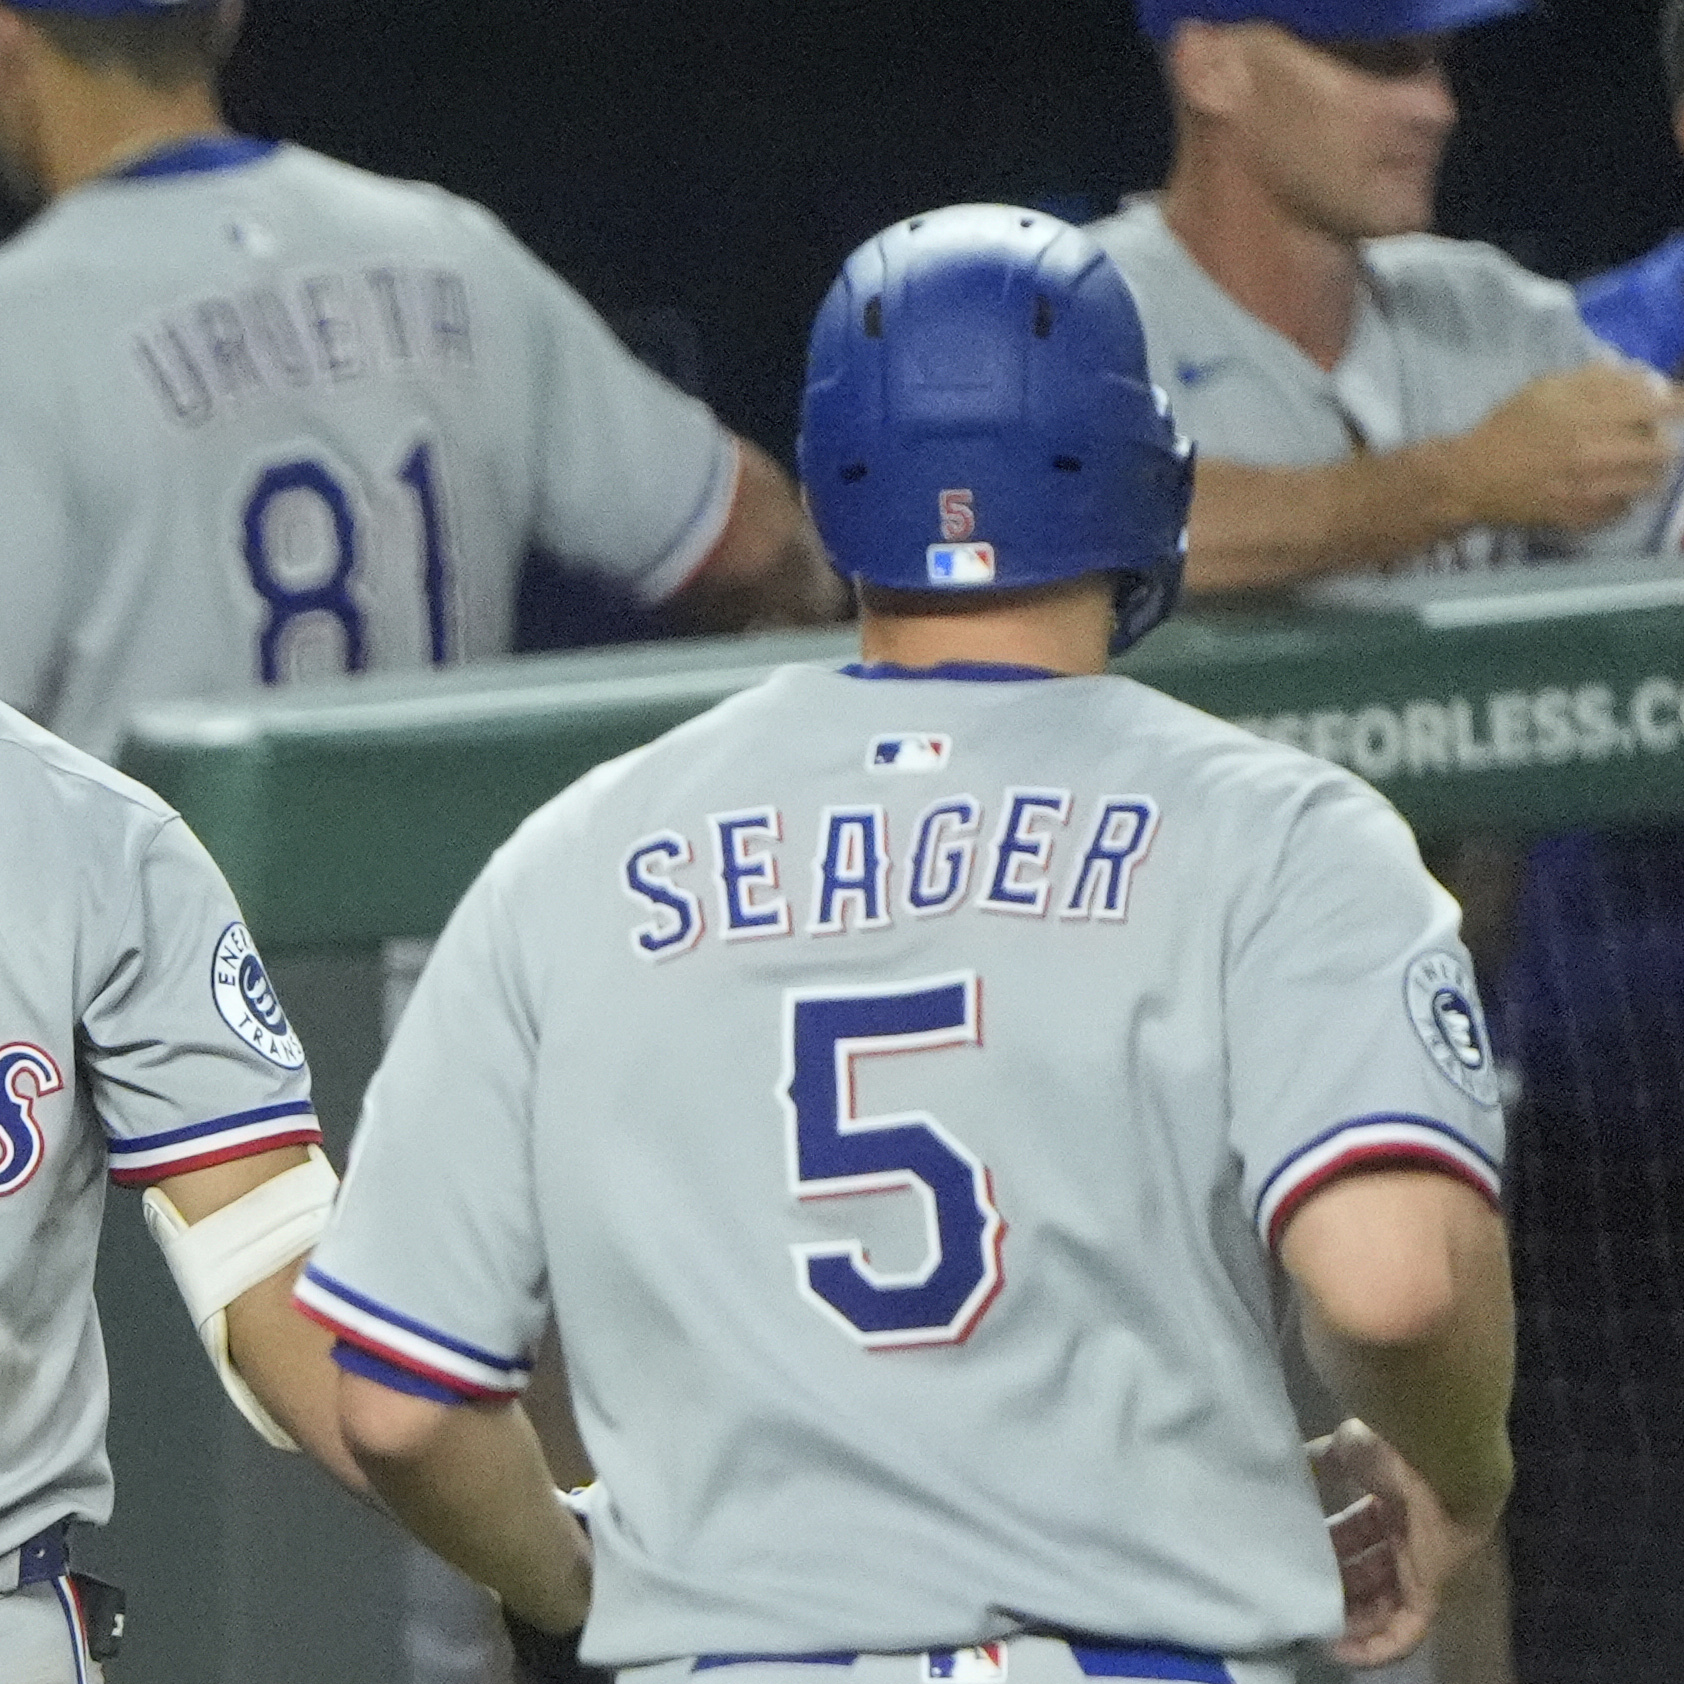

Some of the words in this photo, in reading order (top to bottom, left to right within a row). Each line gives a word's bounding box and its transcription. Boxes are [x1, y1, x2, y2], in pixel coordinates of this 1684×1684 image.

[132, 264, 478, 430] URUETA
[240, 438, 454, 688] 81
[939, 488, 975, 541] 5
[1232, 674, 1684, 779] FORLESS.C
[619, 785, 1160, 965] SEAGER
[775, 968, 1008, 1353] 5
